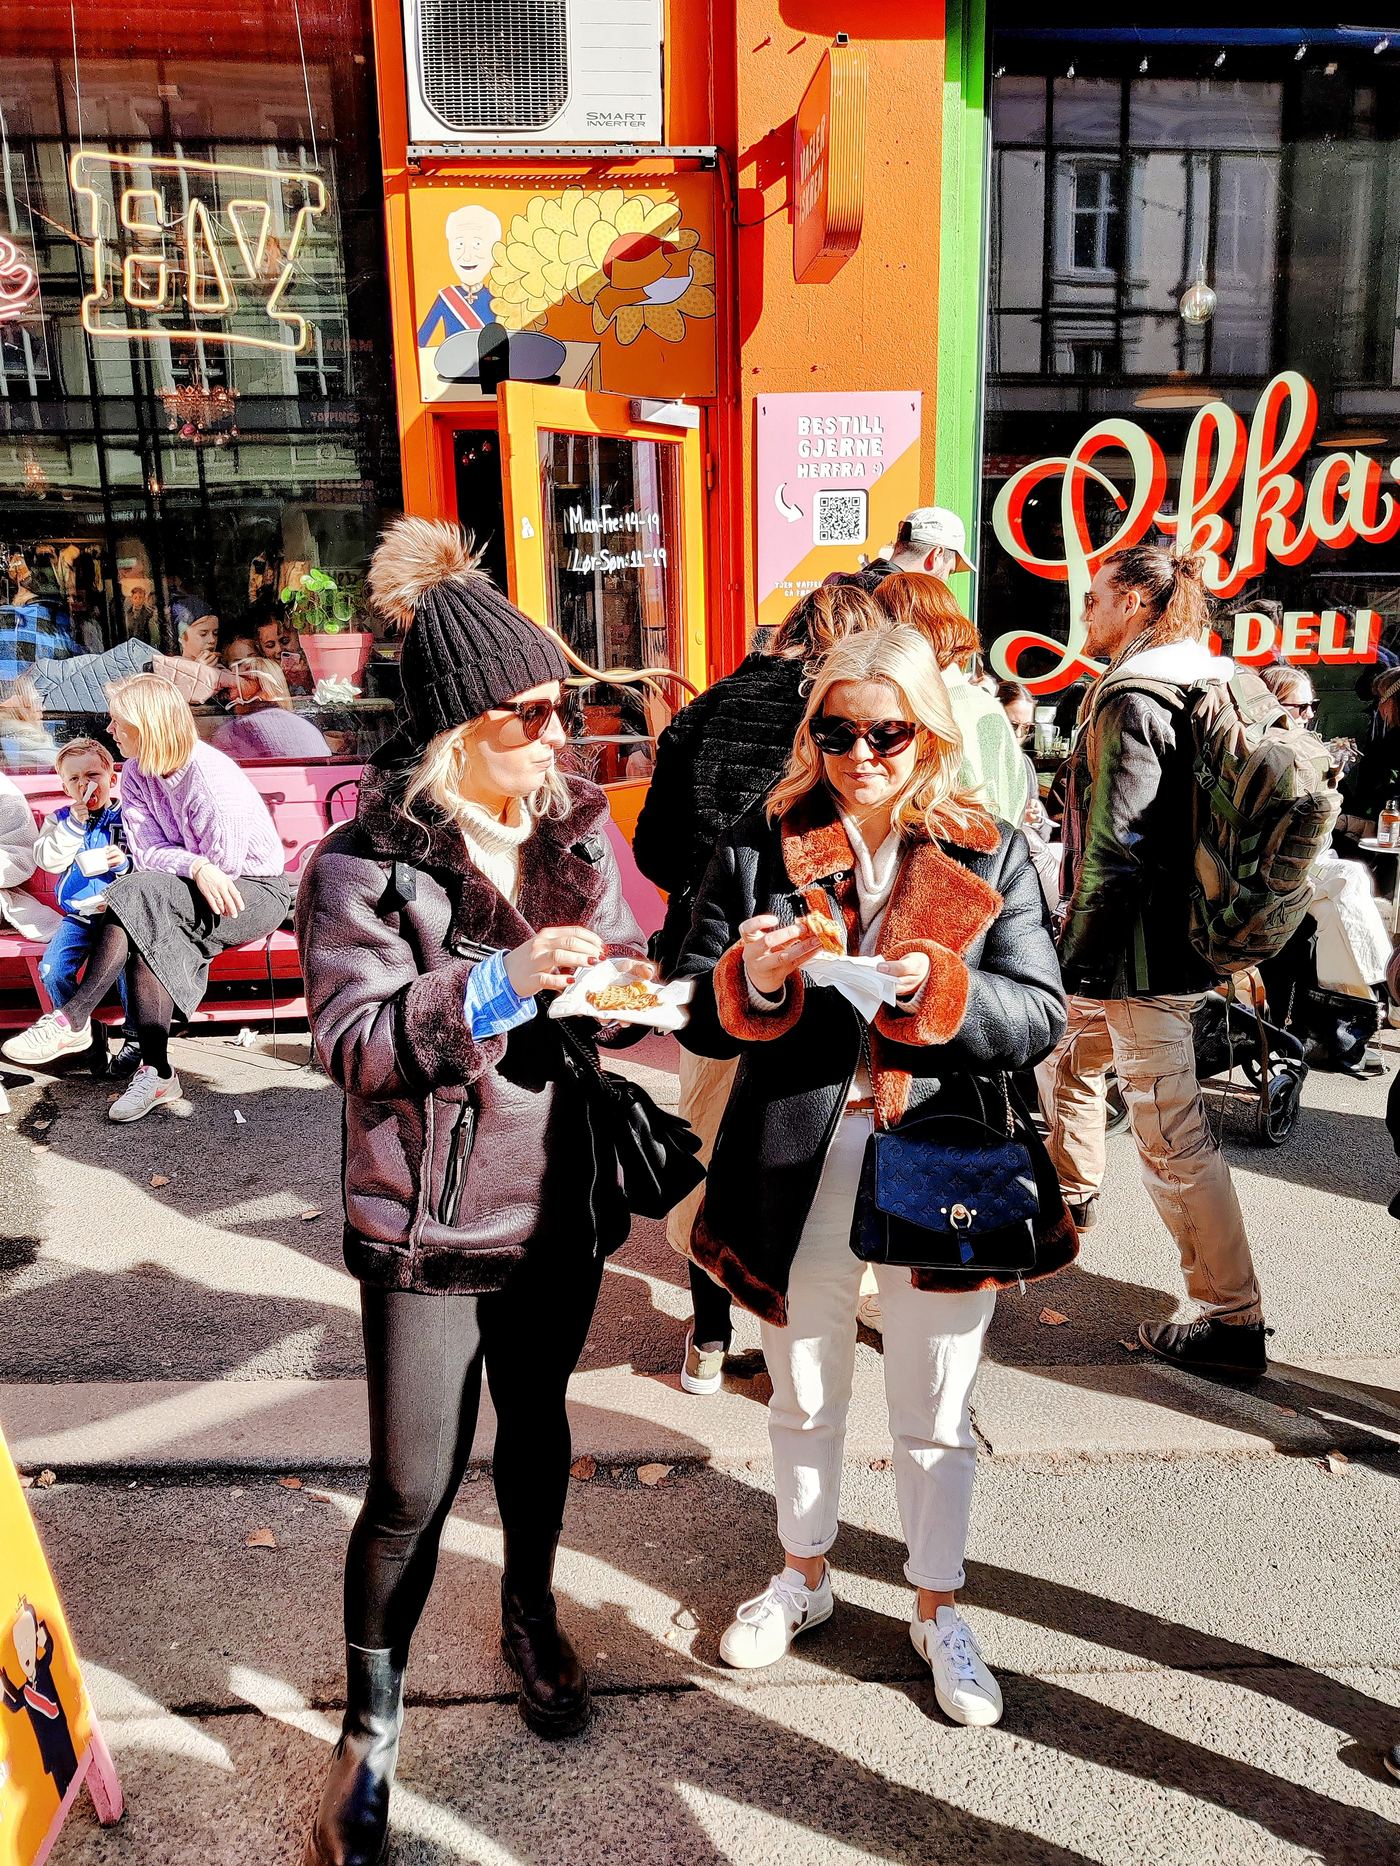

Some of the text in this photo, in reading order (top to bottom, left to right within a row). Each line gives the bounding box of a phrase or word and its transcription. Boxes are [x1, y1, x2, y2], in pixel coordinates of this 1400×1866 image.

[586, 112, 646, 120] SMART
[797, 416, 884, 436] BESTILL
[798, 437, 884, 458] GJERNE
[797, 462, 866, 478] HERFRA
[1232, 609, 1382, 665] DELI
